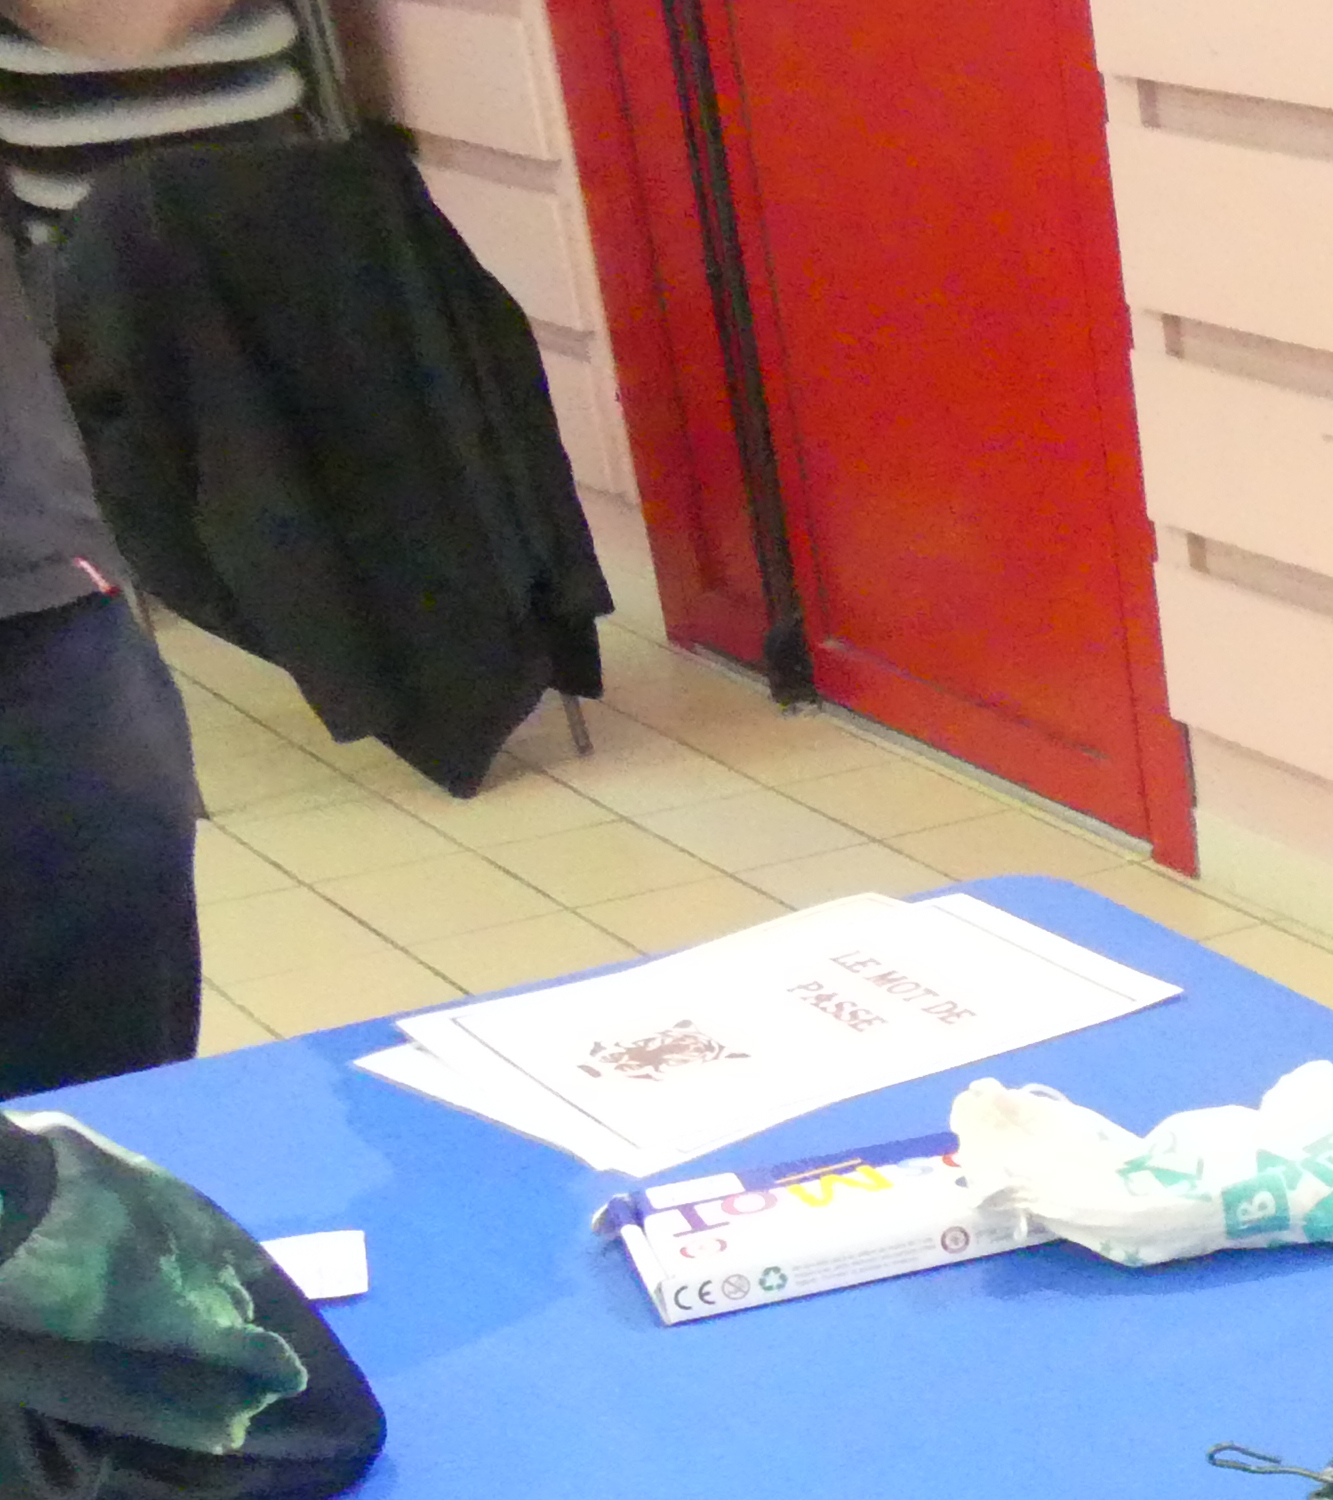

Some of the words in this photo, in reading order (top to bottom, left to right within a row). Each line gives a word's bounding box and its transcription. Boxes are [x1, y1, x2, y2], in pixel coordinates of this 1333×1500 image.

[786, 981, 889, 1033] PASSE
[829, 950, 882, 973] LE
[862, 970, 940, 1002] MOT
[921, 1000, 977, 1024] DE
